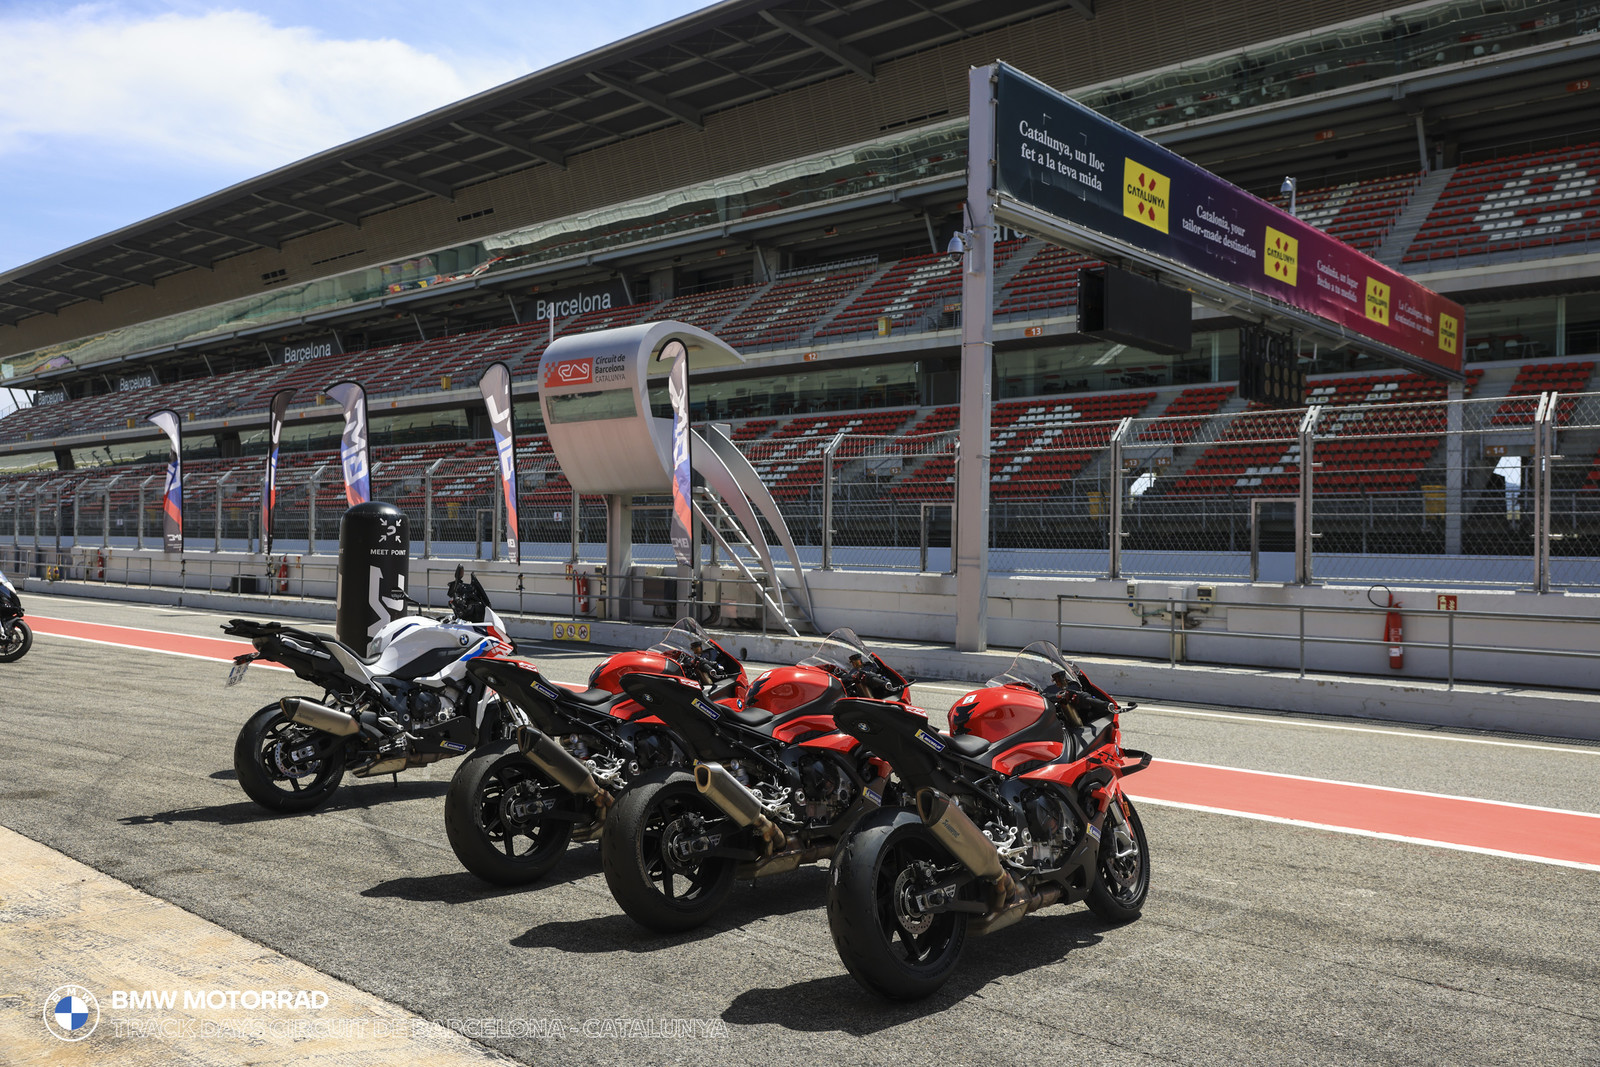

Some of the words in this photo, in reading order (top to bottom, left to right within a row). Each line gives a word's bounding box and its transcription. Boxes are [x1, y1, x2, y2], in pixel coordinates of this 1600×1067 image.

[1576, 80, 1588, 89] 19
[1019, 120, 1072, 160] Catalunya,
[1075, 150, 1087, 164] un
[1089, 152, 1105, 172] lloc
[1021, 143, 1035, 162] fet
[1038, 154, 1044, 165] a
[1046, 153, 1055, 170] la
[1058, 161, 1077, 181] teva
[1079, 172, 1102, 191] mida
[1127, 184, 1166, 209] CATALUNYA
[1196, 205, 1230, 233] Catalonia,
[1230, 224, 1246, 237] your
[1182, 218, 1222, 244] tailor-made
[1223, 234, 1256, 258] destination
[1267, 247, 1295, 264] CATALUNYA
[537, 292, 611, 320] Barcelona
[1032, 327, 1041, 335] 13
[285, 342, 331, 363] Barcelona
[596, 354, 616, 364] Circuit
[595, 364, 625, 374] Barcelona
[595, 373, 626, 383] CATALUNYA
[120, 374, 152, 391] Barcelona
